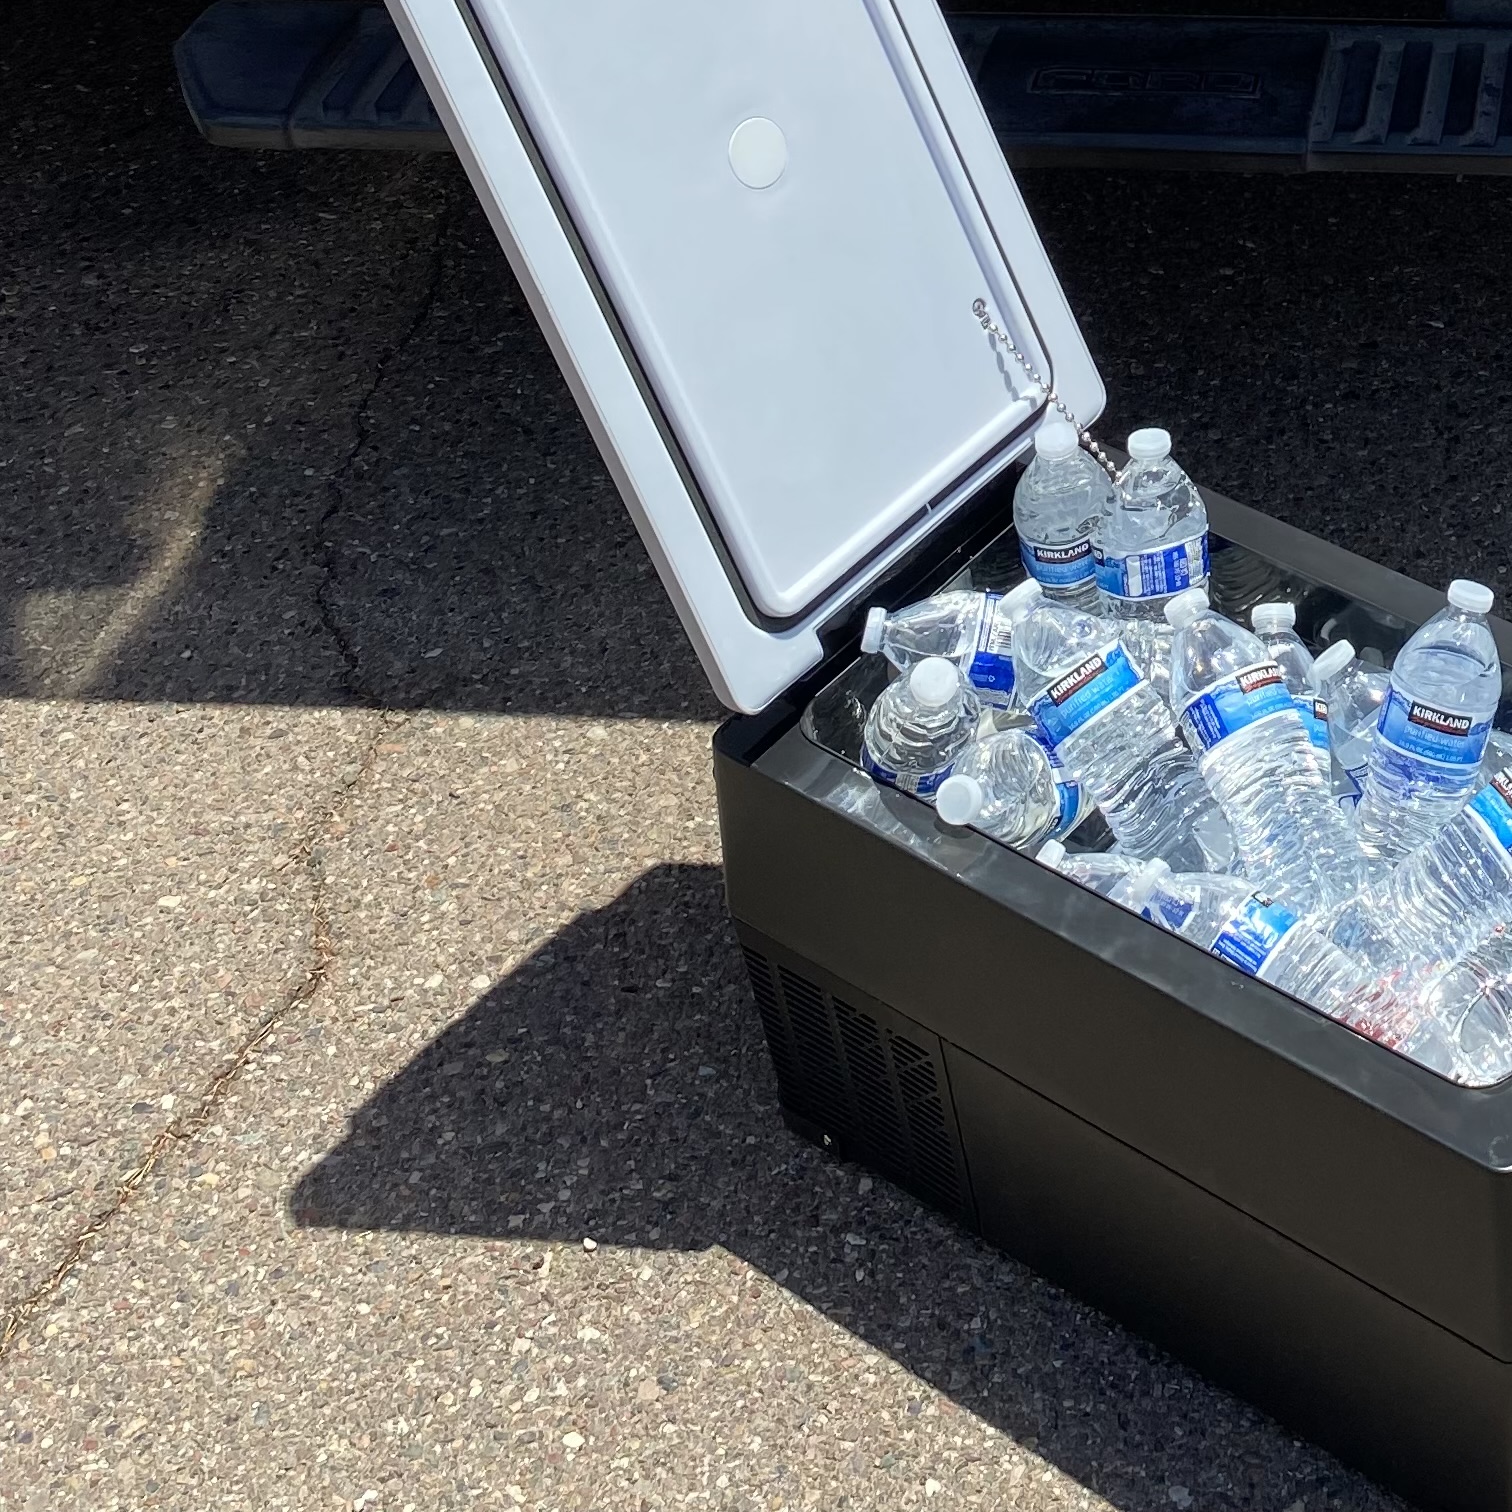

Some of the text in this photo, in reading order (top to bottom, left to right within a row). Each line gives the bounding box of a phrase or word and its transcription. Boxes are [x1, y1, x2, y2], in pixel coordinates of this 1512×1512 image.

[1036, 542, 1090, 560] KIRKLAND
[1050, 656, 1103, 700] KIRKLAND
[1412, 705, 1470, 730] KIRKLAND
